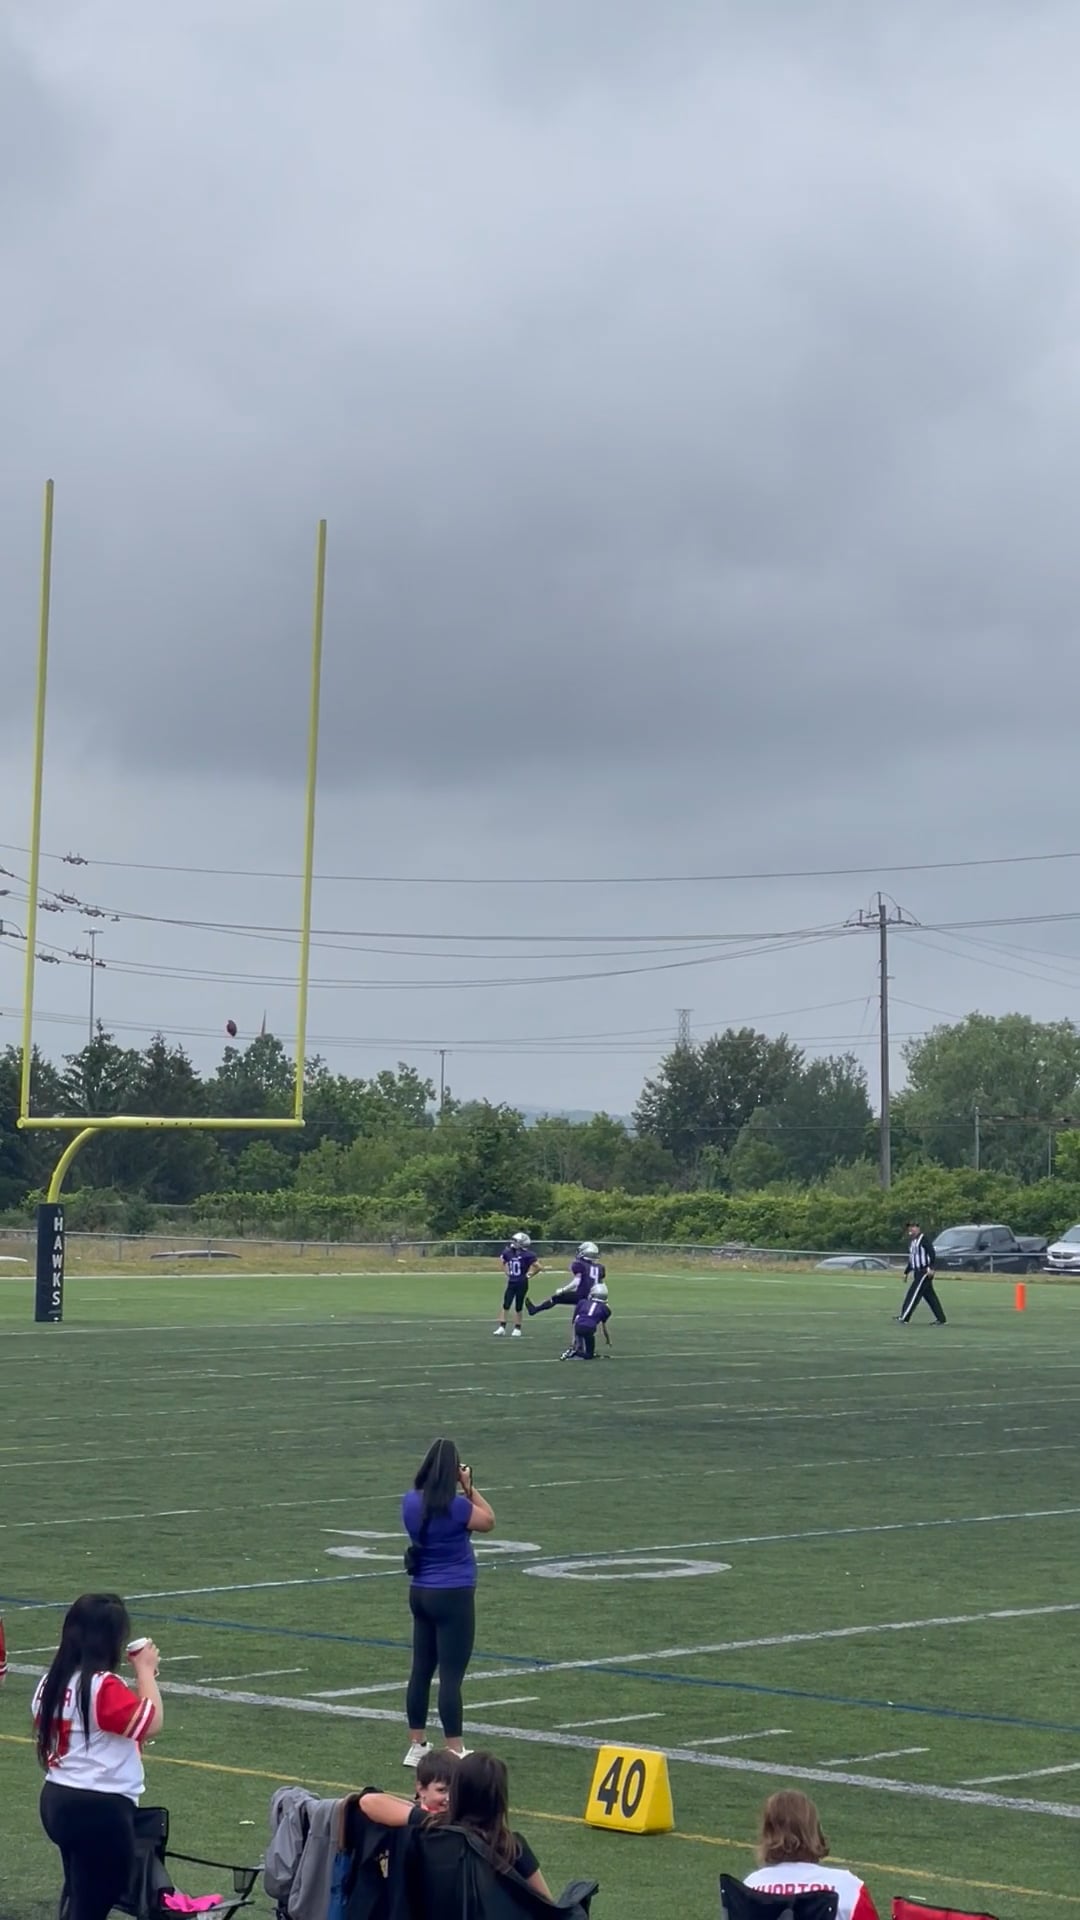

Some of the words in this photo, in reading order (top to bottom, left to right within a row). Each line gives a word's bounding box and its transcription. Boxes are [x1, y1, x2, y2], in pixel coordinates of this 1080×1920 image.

[52, 1216, 63, 1306] HAWKS
[589, 1266, 600, 1284] 4
[597, 1756, 646, 1818] 40
